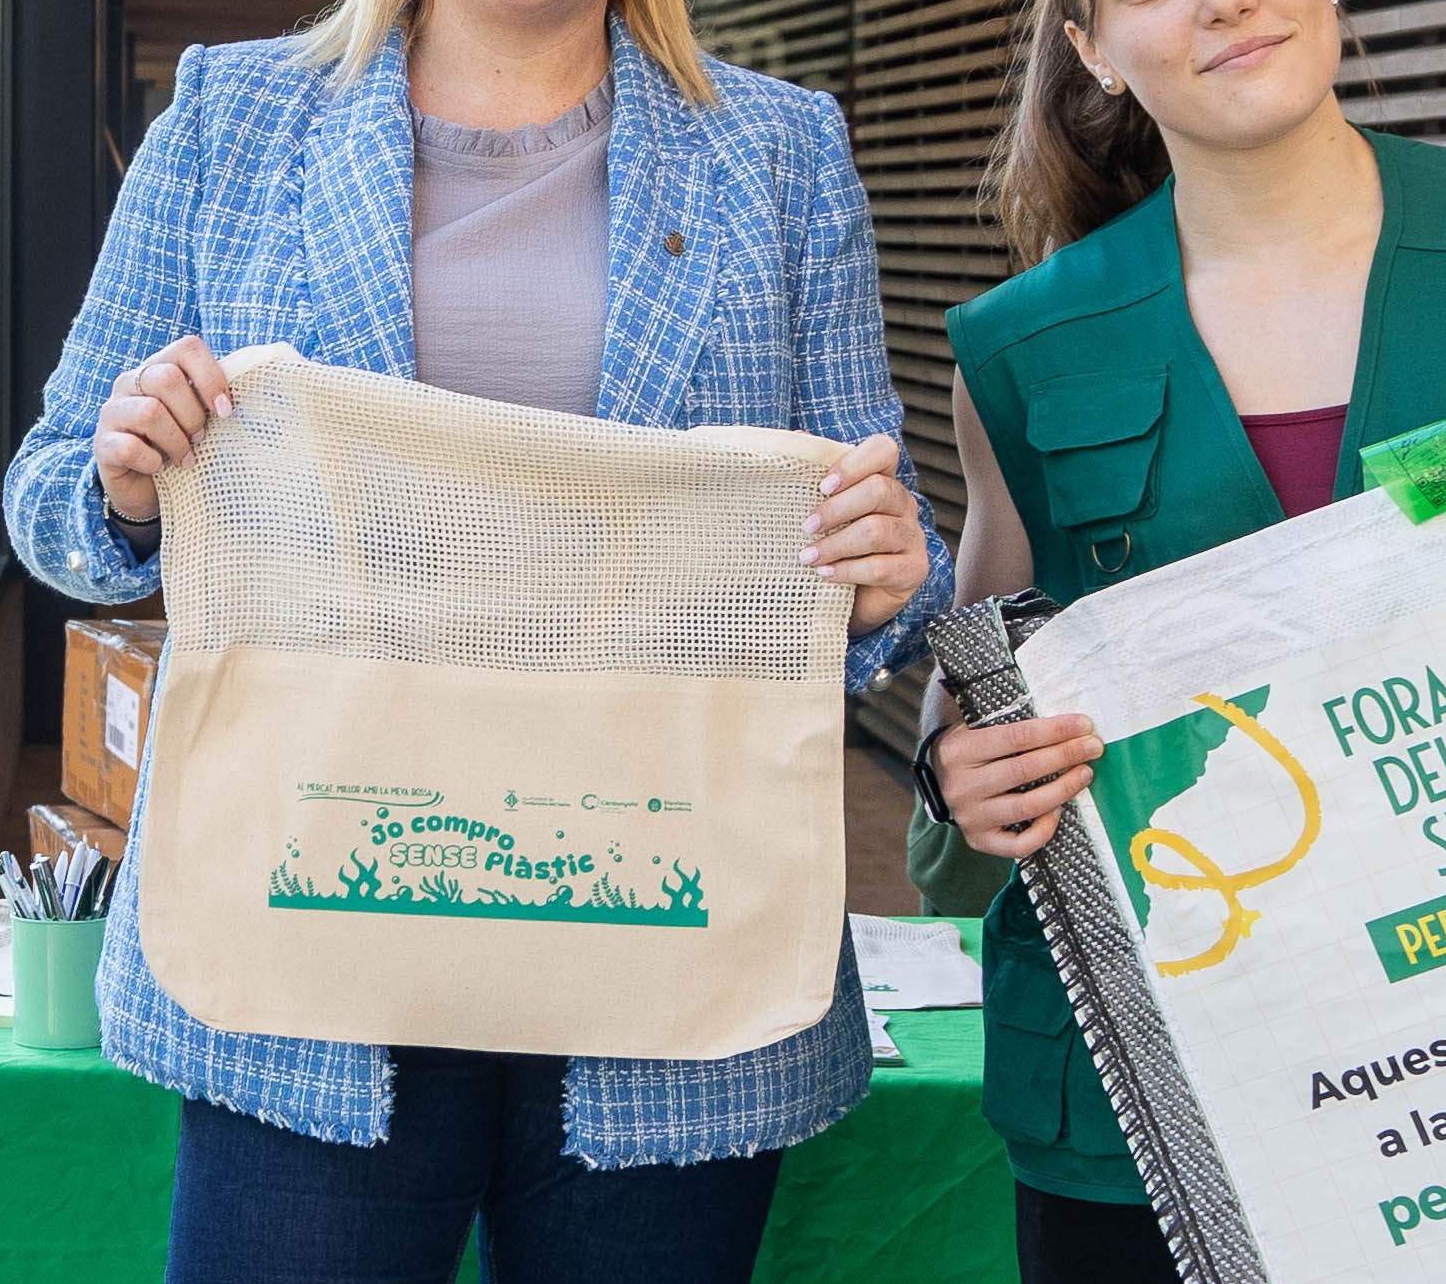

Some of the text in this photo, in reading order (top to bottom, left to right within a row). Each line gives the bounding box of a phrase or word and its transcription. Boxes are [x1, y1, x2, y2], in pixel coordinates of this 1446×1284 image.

[410, 815, 516, 851] compro
[390, 843, 596, 881] SENSE Plàstic
[1376, 1127, 1408, 1157] a
